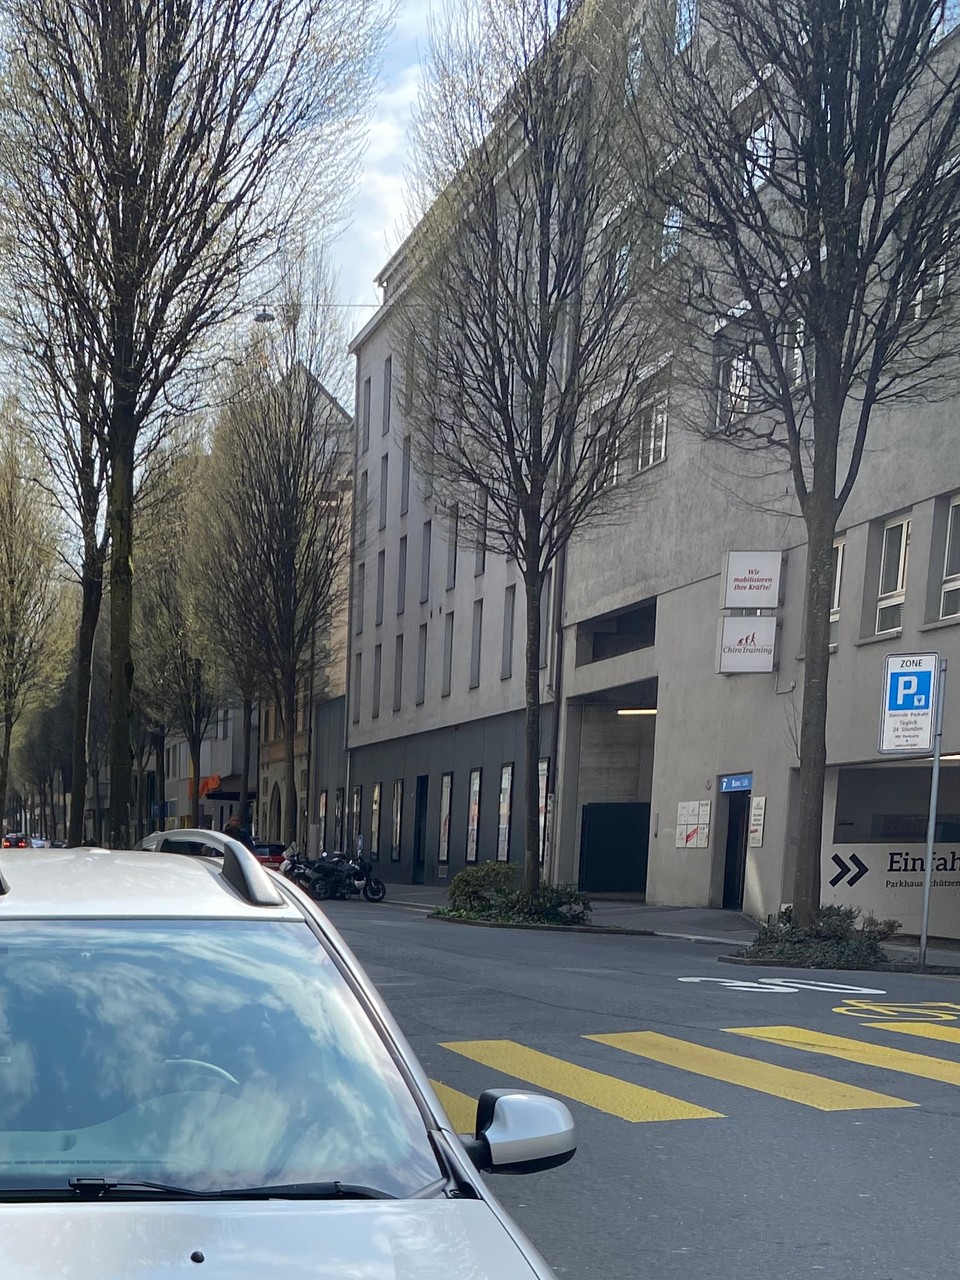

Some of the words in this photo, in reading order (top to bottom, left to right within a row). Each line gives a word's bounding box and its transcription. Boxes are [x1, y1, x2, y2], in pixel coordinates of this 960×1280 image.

[722, 646, 773, 656] ChiroTraining
[900, 659, 923, 668] ZONE
[896, 676, 918, 705] P
[886, 880, 924, 888] Parkhaus
